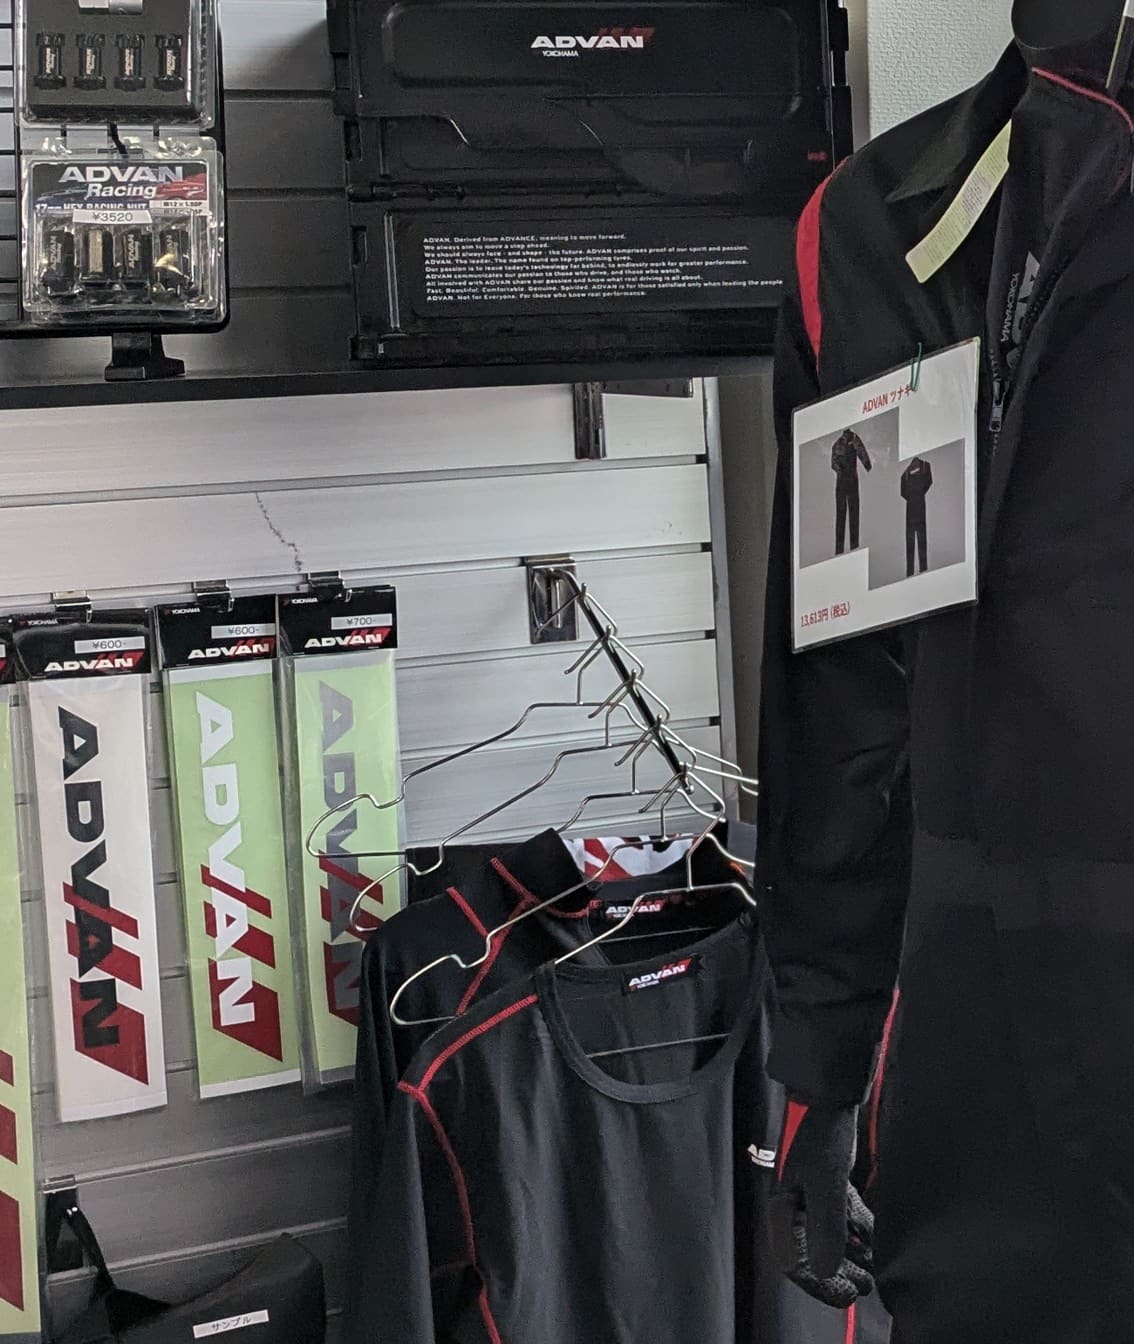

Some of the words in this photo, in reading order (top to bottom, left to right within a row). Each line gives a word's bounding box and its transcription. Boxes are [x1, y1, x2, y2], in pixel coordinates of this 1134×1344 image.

[530, 35, 644, 49] ADVAN
[57, 165, 184, 183] ADVAN
[83, 182, 158, 200] Racing
[1000, 272, 1021, 343] YOKOHAMA
[862, 392, 889, 414] ADVAN
[304, 633, 382, 649] ADVAN
[188, 643, 270, 660] ADVAN
[44, 657, 134, 673] ADVAN
[318, 680, 362, 1011] ADVAN
[195, 691, 256, 1027] ADVAN
[57, 705, 120, 1050] ADVAN
[628, 964, 686, 986] ADVAN
